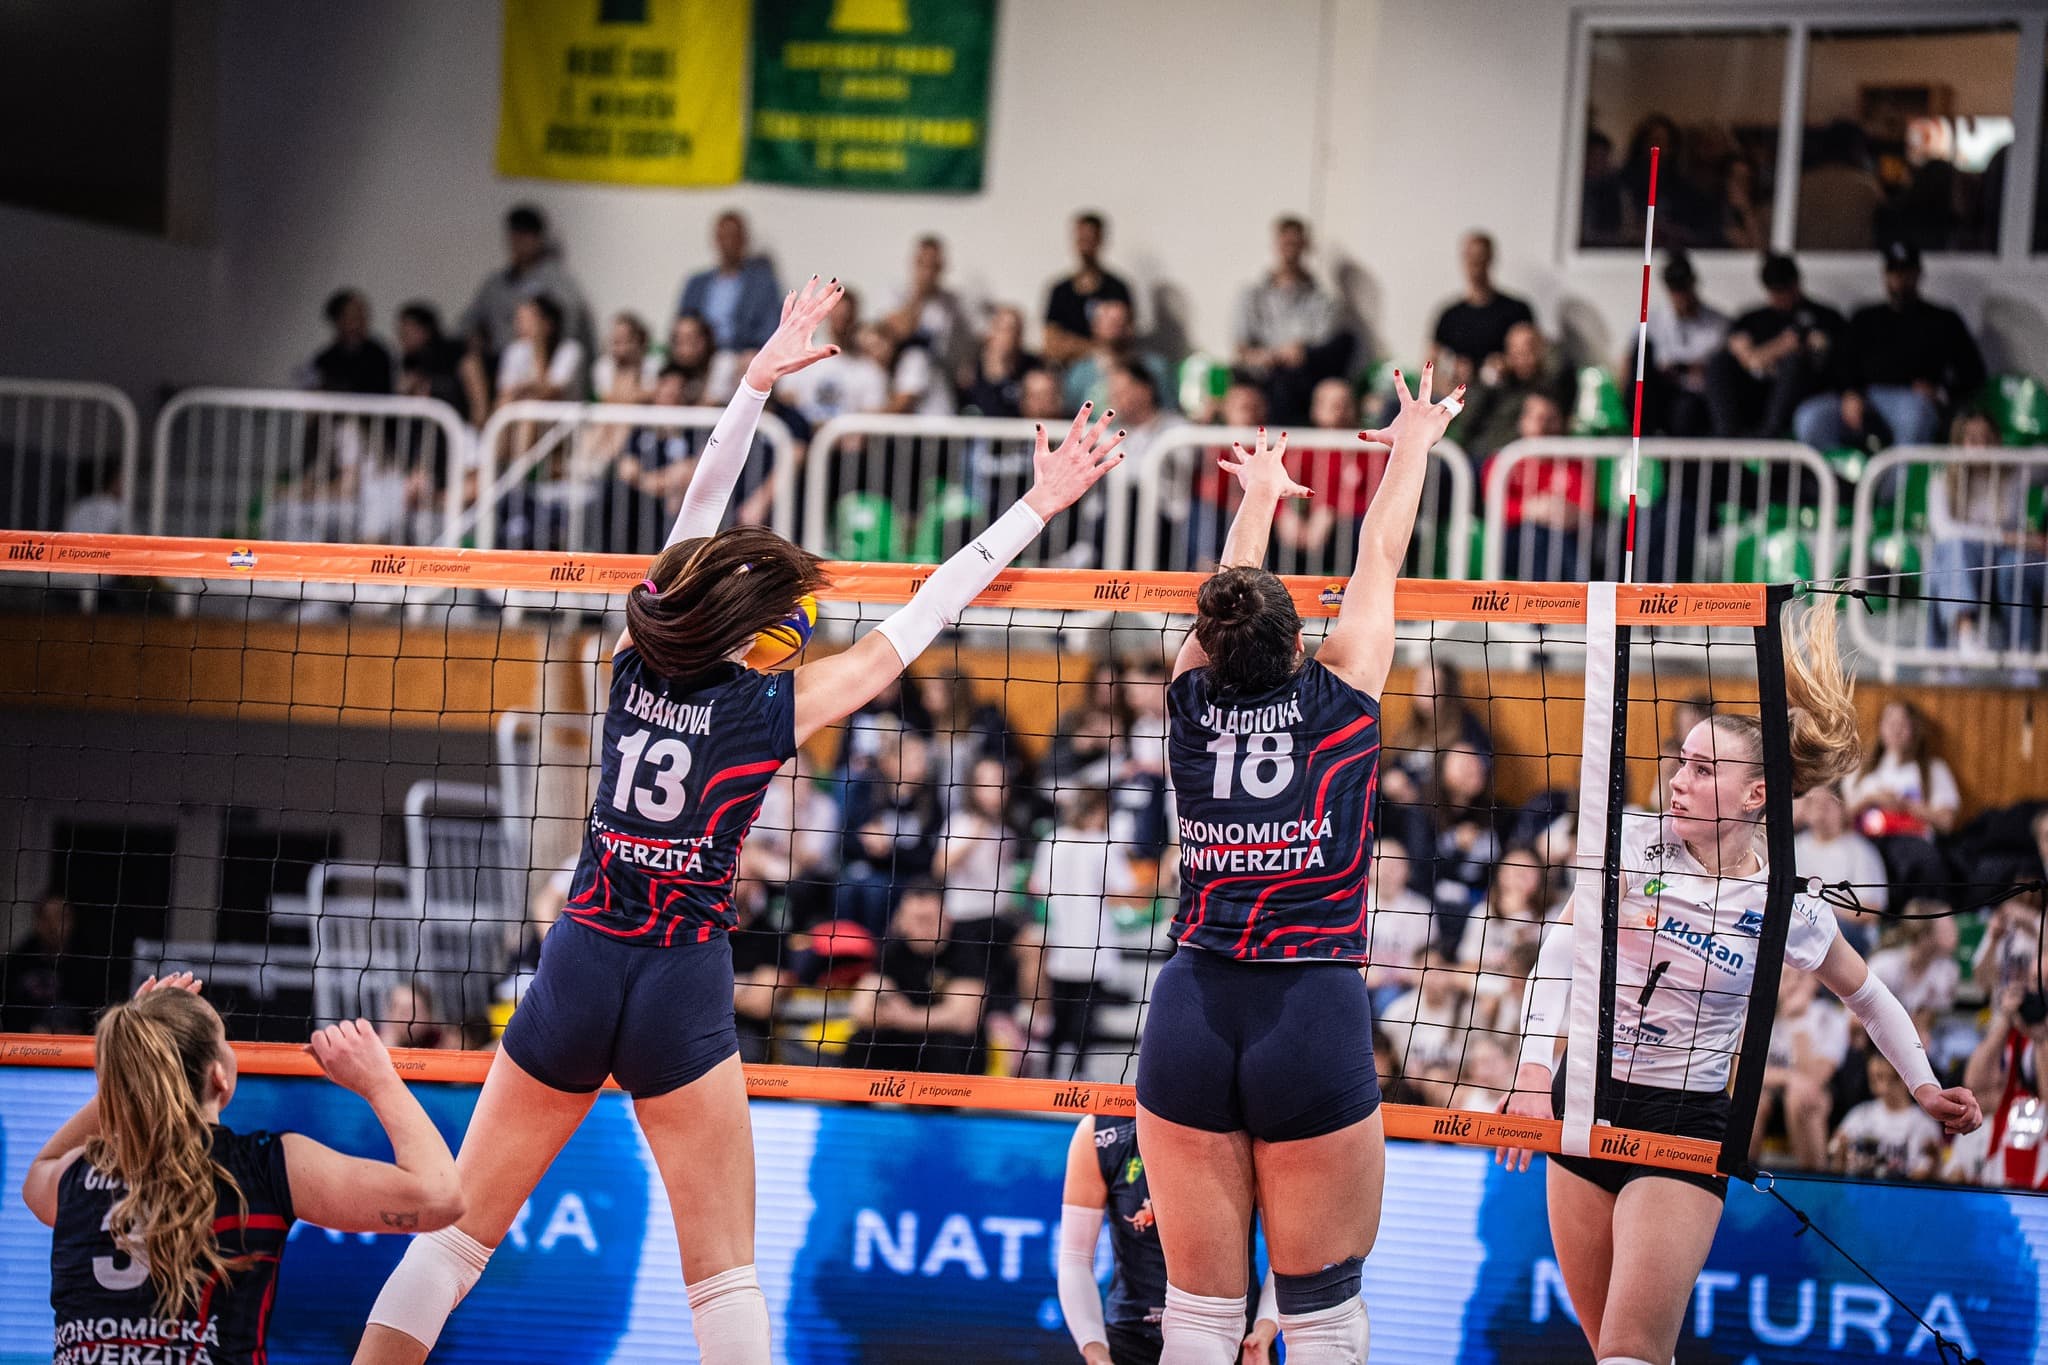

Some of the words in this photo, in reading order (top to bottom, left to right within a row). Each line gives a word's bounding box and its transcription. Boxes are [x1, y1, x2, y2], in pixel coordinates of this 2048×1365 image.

[9, 540, 45, 560] niké
[58, 548, 68, 559] je
[69, 548, 111, 560] tipovanie
[371, 554, 406, 574] niké
[419, 561, 428, 573] je
[429, 562, 471, 574] tipovanie
[550, 561, 585, 581] niké
[599, 569, 608, 580] je
[609, 569, 647, 580] tipovani
[1094, 579, 1130, 600] niké
[1144, 586, 1153, 598] je
[1154, 587, 1198, 599] tipovanie
[1472, 590, 1510, 611] niké
[1524, 597, 1534, 609] je
[1535, 598, 1581, 610] tipovanie
[1640, 592, 1679, 614] niké
[1693, 600, 1703, 612] je
[1705, 599, 1752, 612] tipovanie
[623, 683, 715, 735] LIBÁKOVÁ
[612, 729, 692, 822] 13
[1206, 732, 1295, 800] 18
[1179, 810, 1333, 845] EKONOMICKÁ
[602, 834, 703, 874] VERZITA
[1181, 843, 1326, 872] UNIVERZITA
[1663, 916, 1744, 969] Klokan
[8, 1047, 19, 1057] je
[20, 1046, 62, 1057] tipovanie
[869, 1076, 906, 1098] niké
[918, 1085, 928, 1096] je
[929, 1085, 972, 1097] tipovanie
[1053, 1087, 1090, 1108] niké
[1103, 1095, 1112, 1107] je
[1114, 1096, 1136, 1108] tipov
[1433, 1114, 1472, 1137] niké
[1485, 1125, 1496, 1136] je
[1497, 1126, 1543, 1140] tipovanie
[1600, 1134, 1640, 1157] niké
[1654, 1146, 1665, 1158] je
[1666, 1148, 1713, 1164] tipovanie
[1530, 1257, 1978, 1358] NTURA
[55, 1315, 220, 1349] KONOMICKÁ
